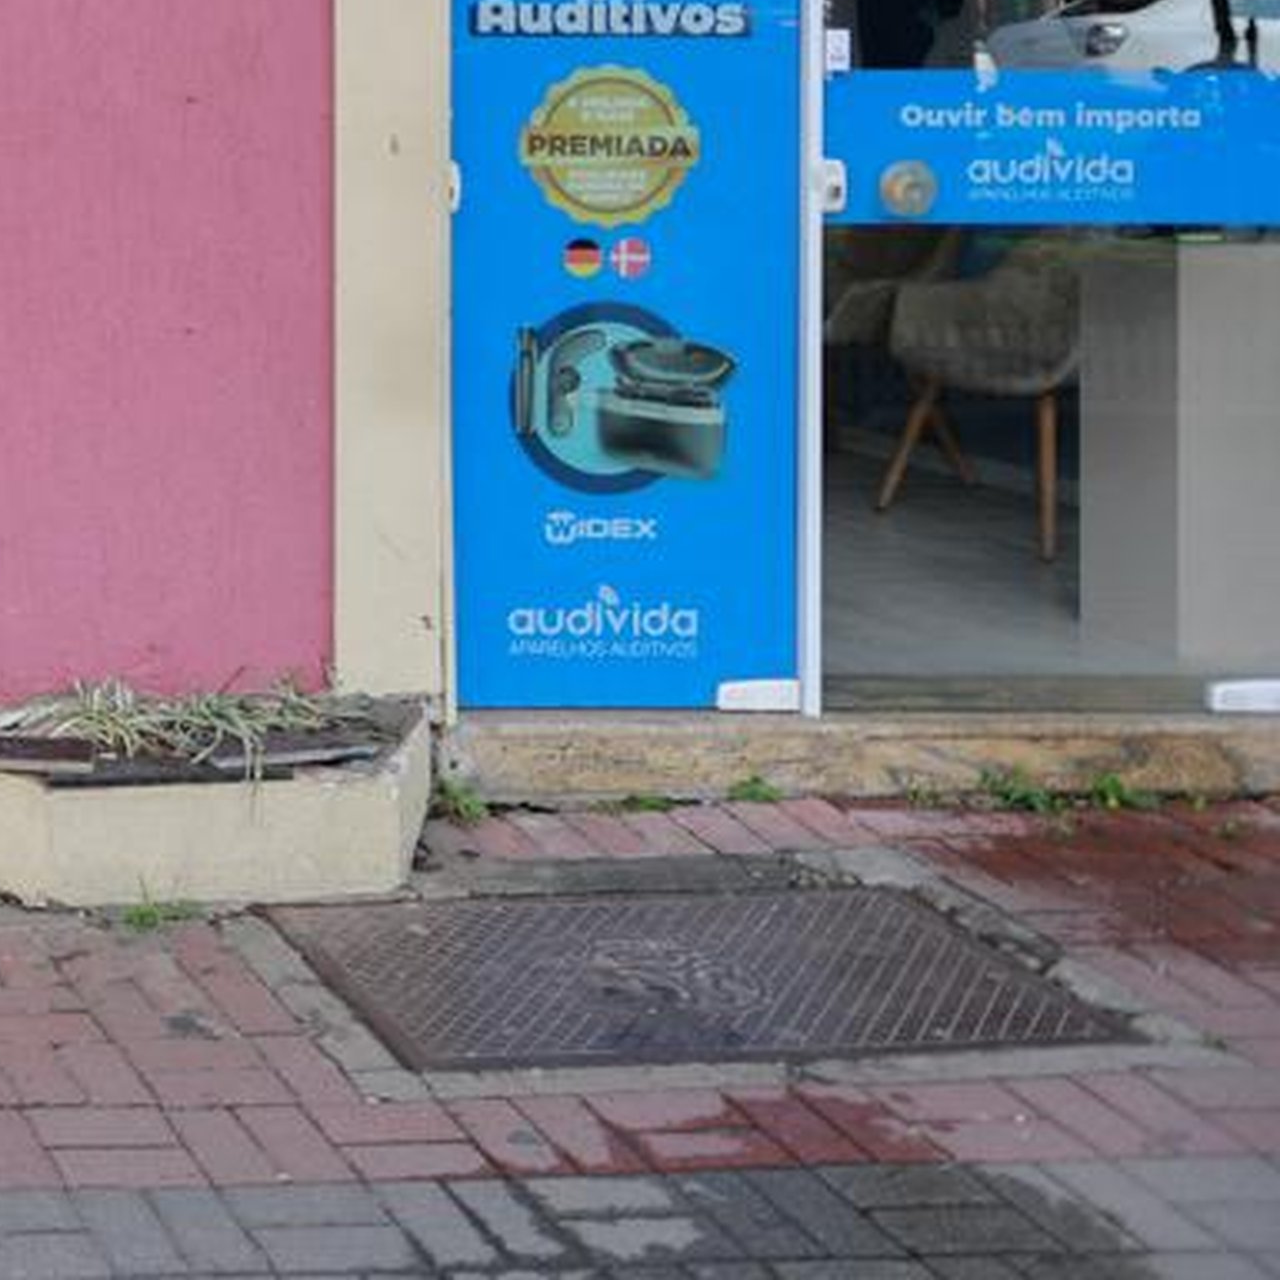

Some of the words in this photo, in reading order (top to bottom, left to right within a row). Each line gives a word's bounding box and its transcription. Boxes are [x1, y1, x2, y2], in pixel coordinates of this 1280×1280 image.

[901, 102, 987, 128] Ouvir
[996, 102, 1065, 128] bem
[1075, 102, 1201, 134] importa
[527, 134, 690, 158] PREMIADA
[968, 155, 1134, 185] audivida
[508, 600, 699, 637] audivida
